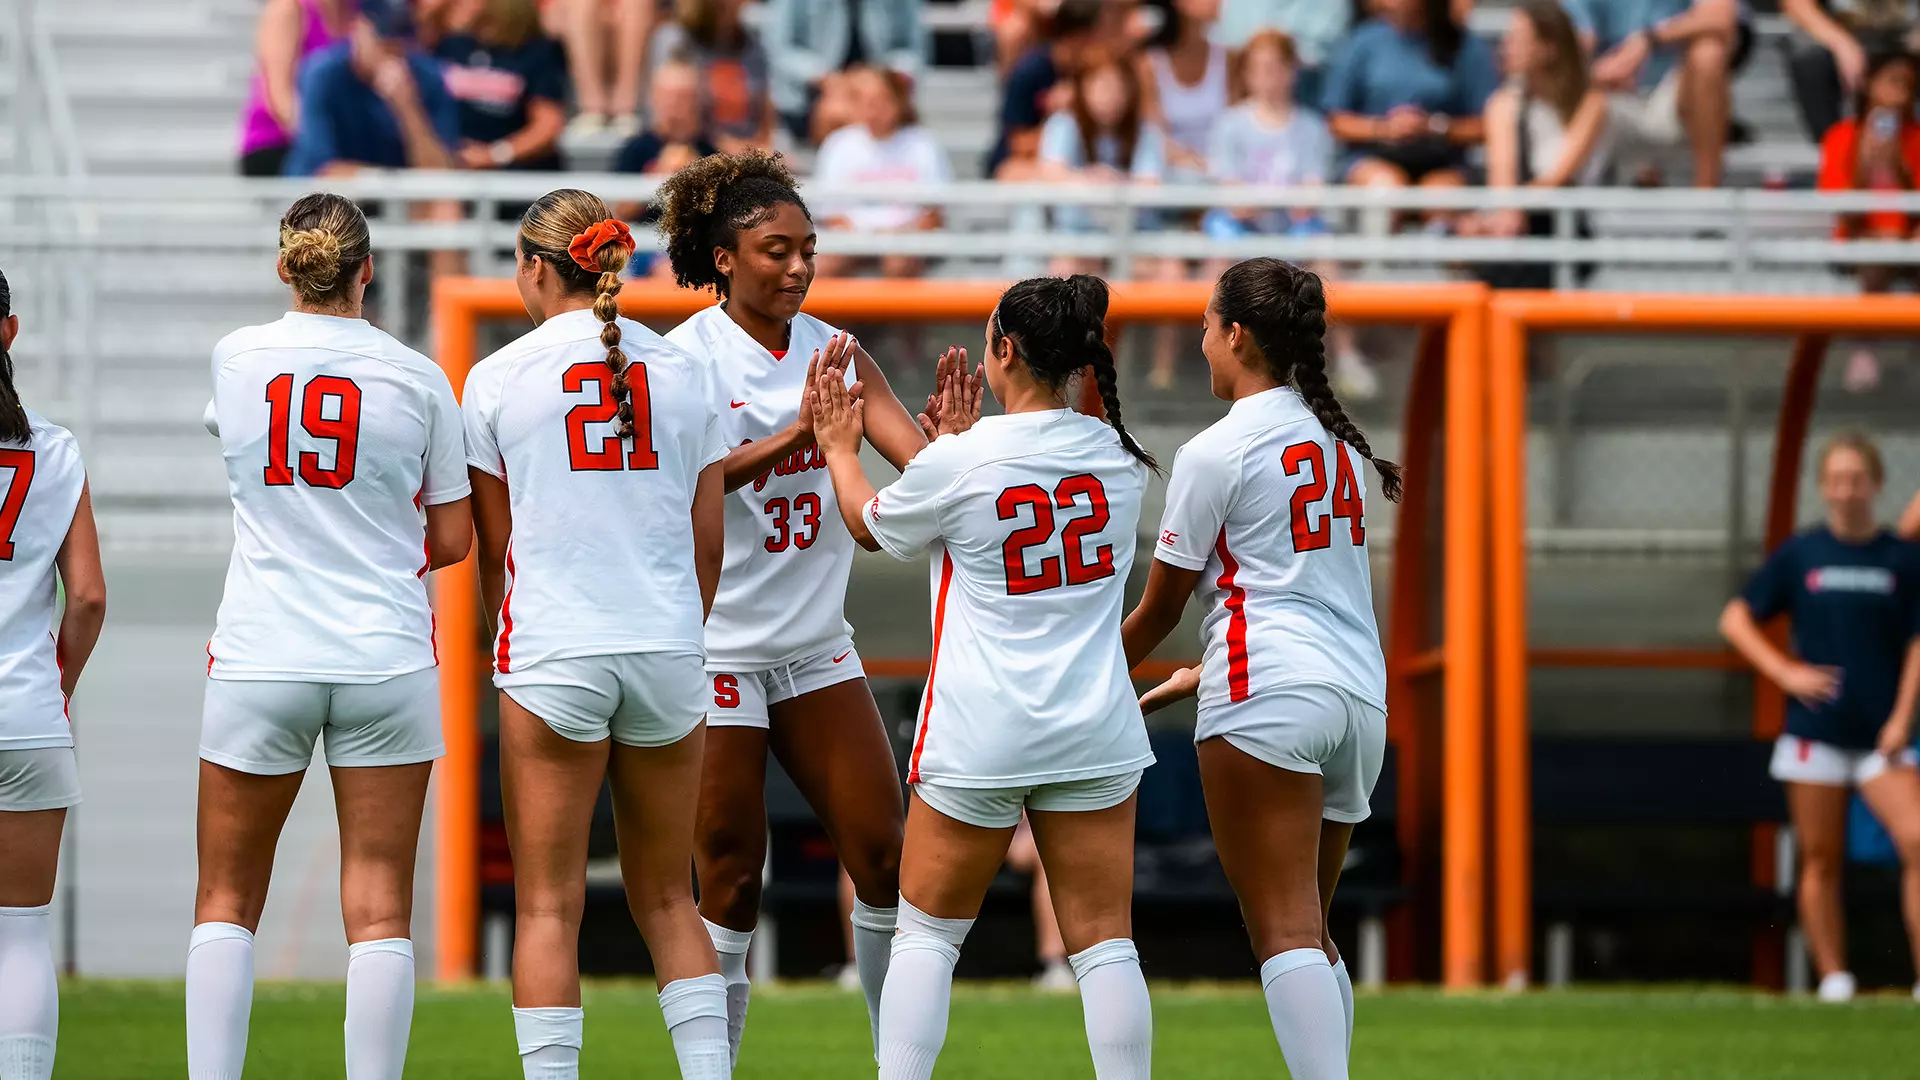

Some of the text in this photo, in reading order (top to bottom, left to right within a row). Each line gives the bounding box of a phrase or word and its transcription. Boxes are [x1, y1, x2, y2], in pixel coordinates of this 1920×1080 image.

[264, 373, 362, 490] 19
[562, 361, 659, 472] 21
[764, 492, 821, 553] 33
[995, 472, 1116, 596] 22
[1280, 440, 1366, 554] 24
[713, 673, 740, 708] S
